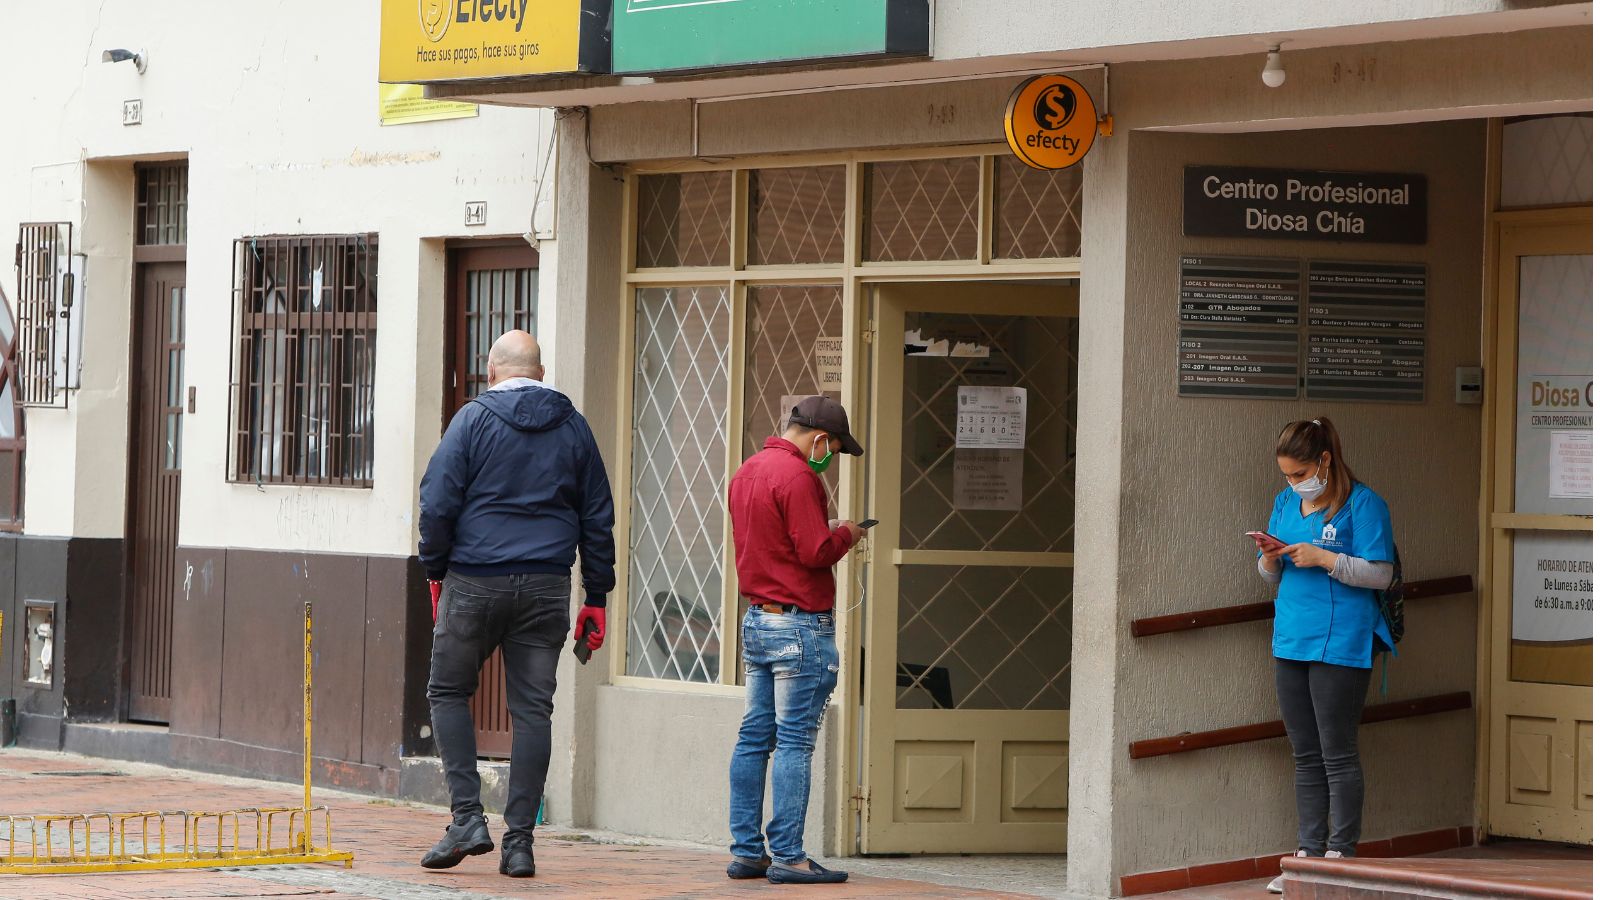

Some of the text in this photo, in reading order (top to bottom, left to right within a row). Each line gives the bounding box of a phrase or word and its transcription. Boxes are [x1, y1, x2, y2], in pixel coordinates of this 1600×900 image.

[416, 40, 540, 64] Hace sus pagos, hace sus giros
[1026, 130, 1080, 156] efecty
[1203, 176, 1409, 205] Centro Profesional
[1246, 208, 1364, 234] Diosa Chía
[1532, 380, 1579, 406] Diosa
[1532, 416, 1551, 426] CENTRO
[1552, 416, 1588, 426] PROFESIONAL
[1537, 559, 1567, 572] HORARIO
[1569, 561, 1577, 572] DE
[1544, 578, 1553, 590] De
[1554, 579, 1572, 591] Lunes
[1574, 582, 1577, 591] a
[1534, 596, 1542, 608] de
[1544, 597, 1559, 609] 6:30
[1560, 600, 1574, 610] a.m.
[1575, 601, 1579, 610] a
